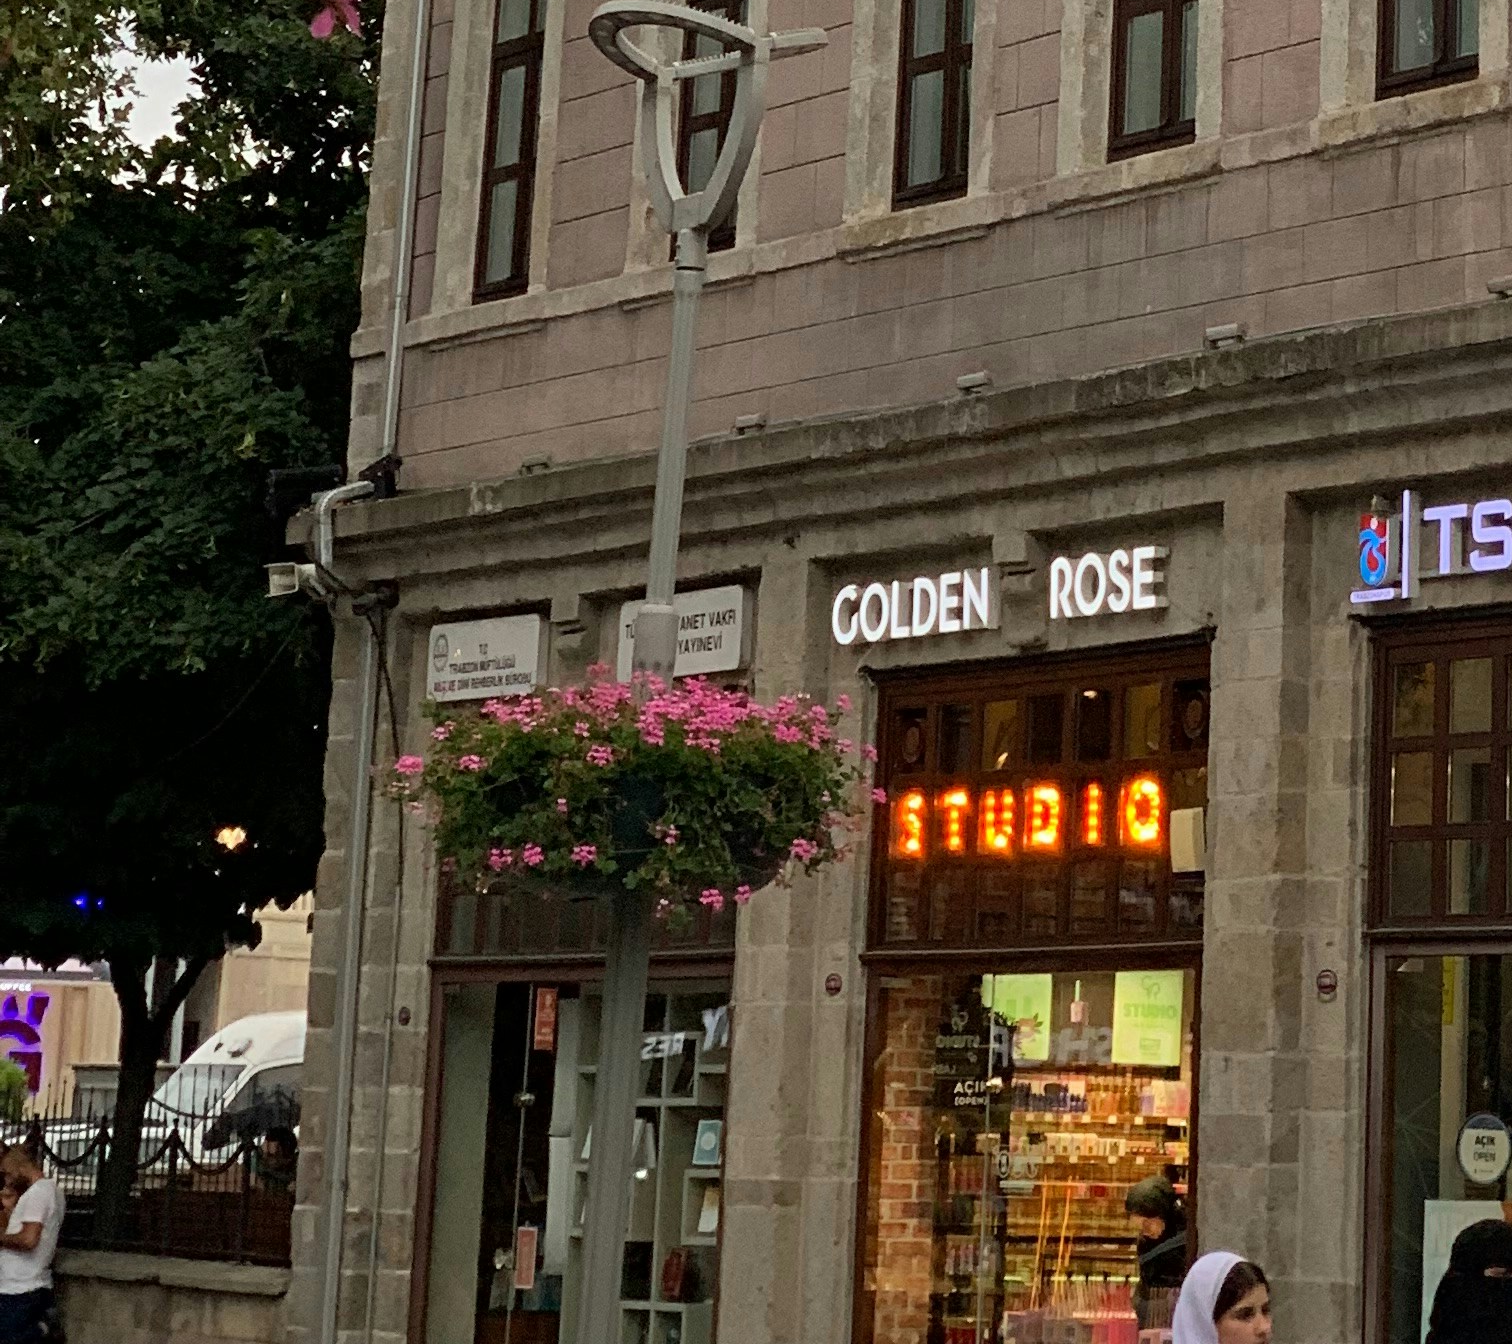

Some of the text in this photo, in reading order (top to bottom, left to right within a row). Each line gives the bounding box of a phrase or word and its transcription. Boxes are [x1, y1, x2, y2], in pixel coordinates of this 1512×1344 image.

[832, 546, 1157, 645] GOLDEN ROSE
[893, 775, 1162, 855] STUDIO
